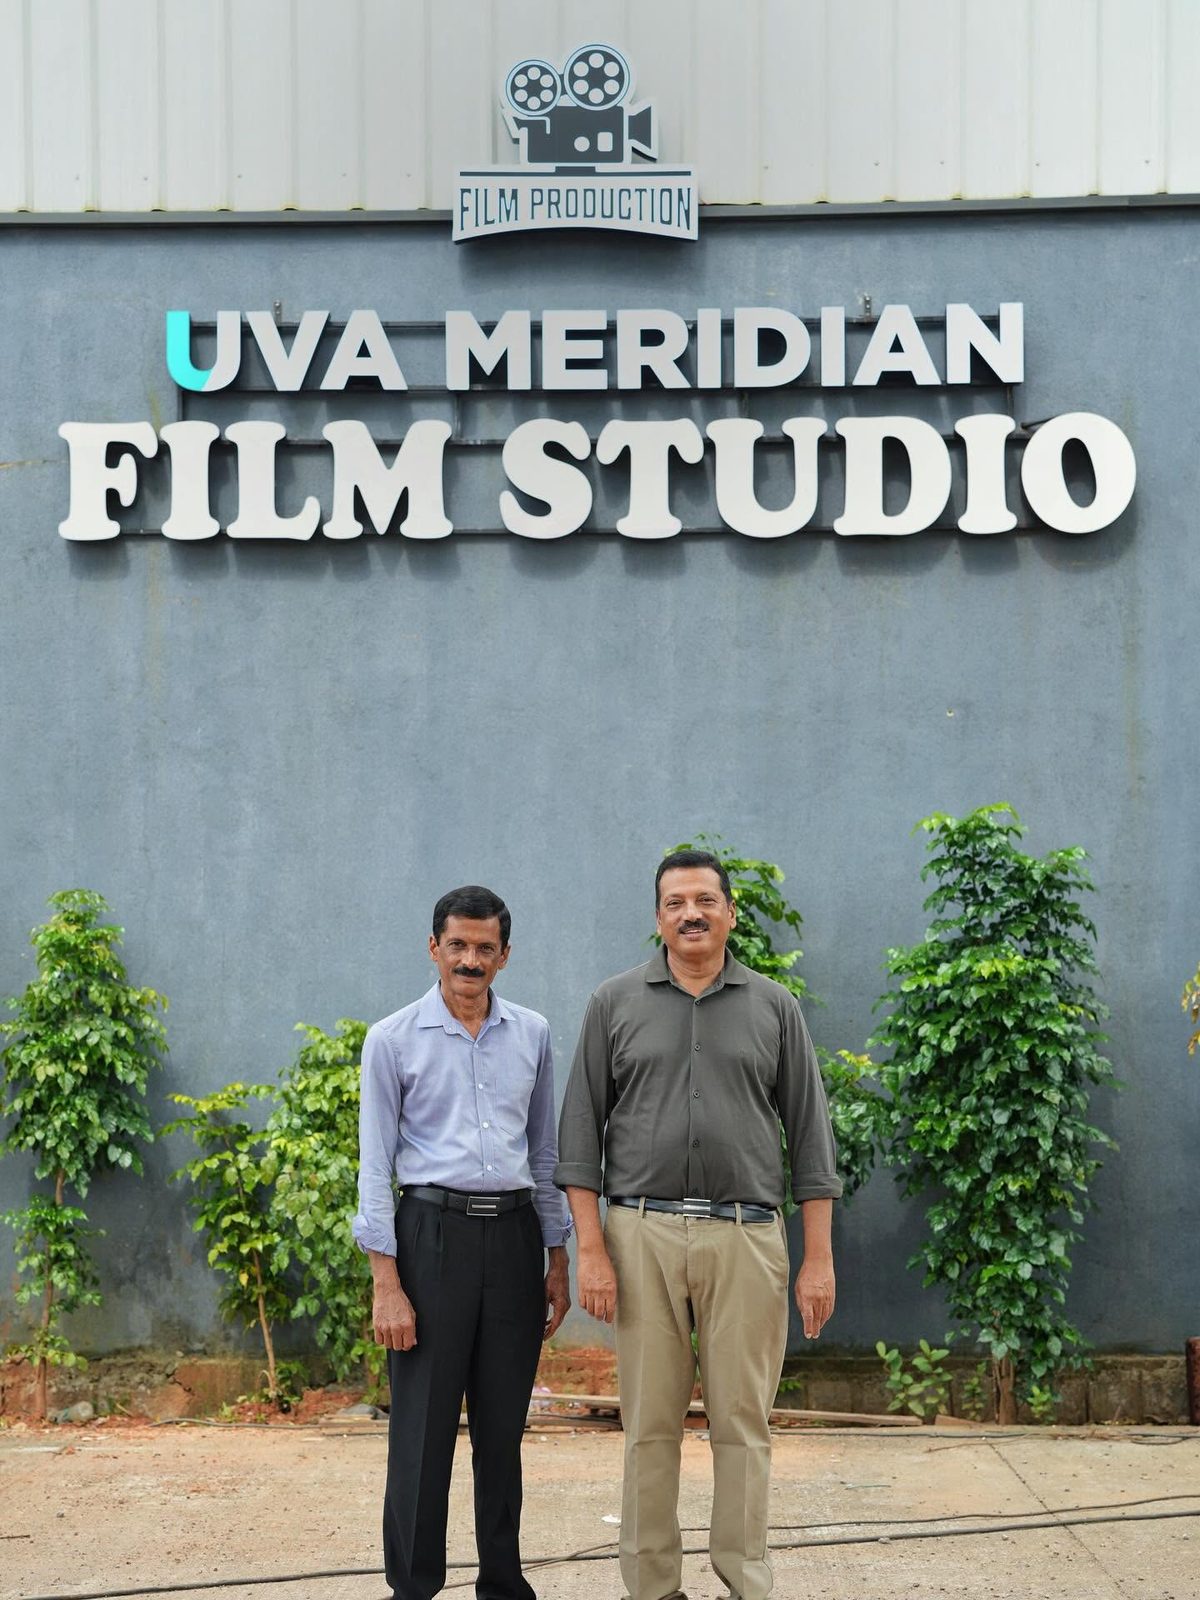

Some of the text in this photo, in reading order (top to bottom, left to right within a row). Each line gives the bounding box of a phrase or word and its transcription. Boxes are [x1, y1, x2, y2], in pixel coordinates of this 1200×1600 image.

[459, 187, 692, 231] FILM PRODUCTION
[165, 302, 1024, 392] UVA MERIDIAN
[58, 411, 1137, 541] FILM STUDIO
